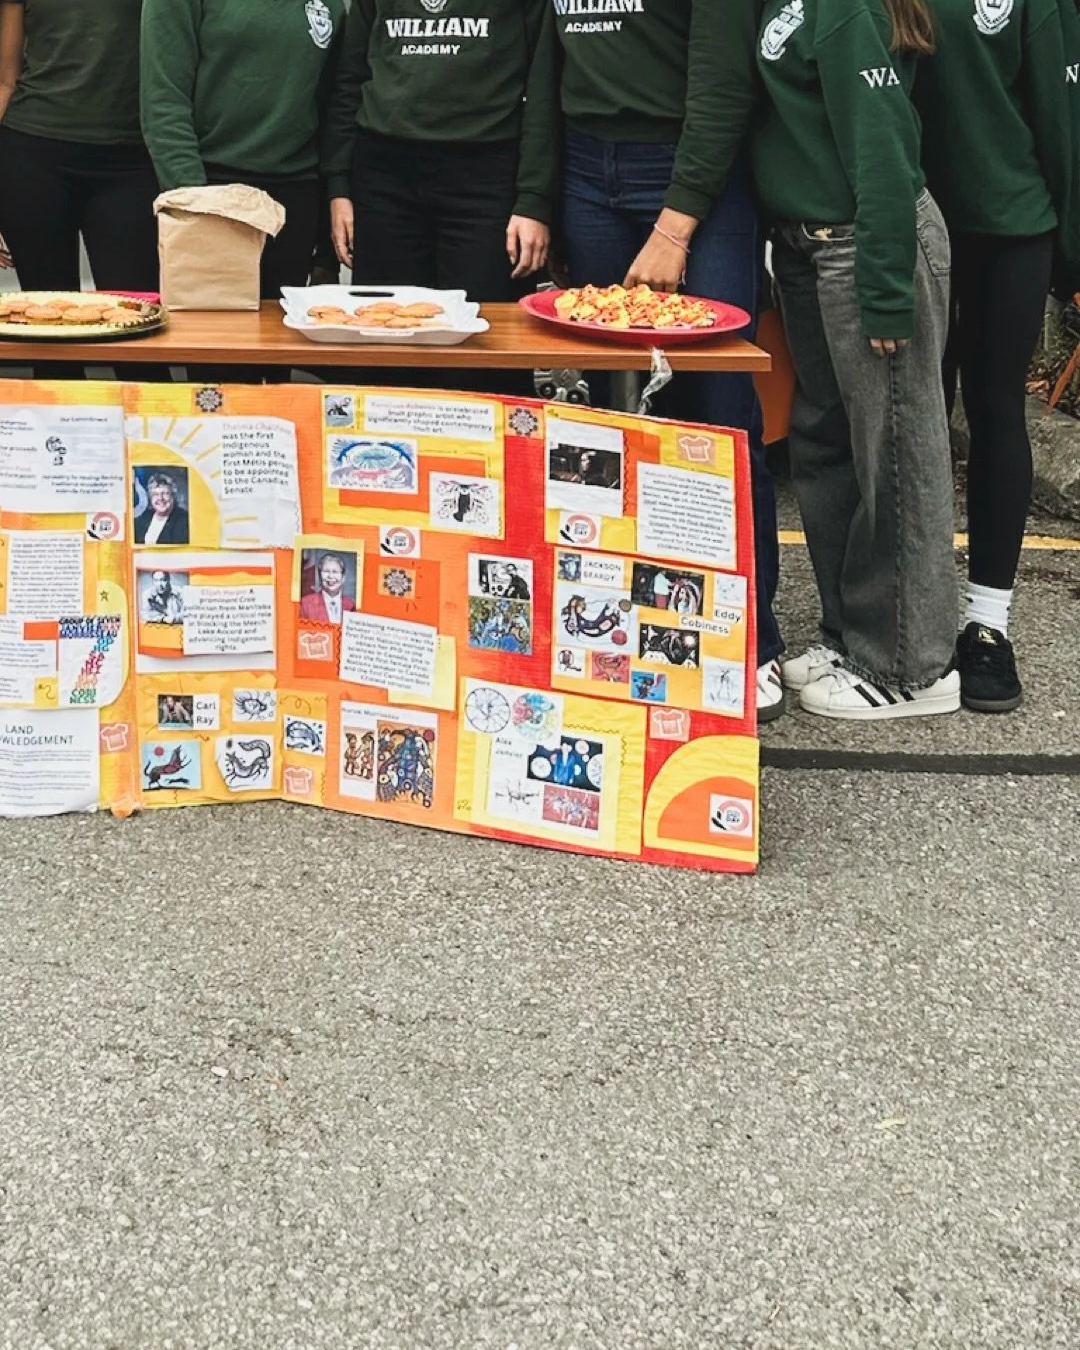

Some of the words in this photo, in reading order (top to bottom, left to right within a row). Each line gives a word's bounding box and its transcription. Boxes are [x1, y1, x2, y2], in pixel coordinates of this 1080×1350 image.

[385, 18, 489, 38] WILLIAM
[565, 21, 622, 33] ACADEMY
[401, 45, 461, 55] ACADEMY
[859, 67, 900, 89] WA
[274, 451, 285, 459] the
[248, 469, 288, 477] appointed
[251, 477, 288, 487] Canadian
[715, 610, 741, 623] Eddy
[681, 617, 728, 634] Cobiness
[197, 701, 216, 710] Carl
[197, 716, 214, 726] Ray
[5, 724, 34, 735] LAND
